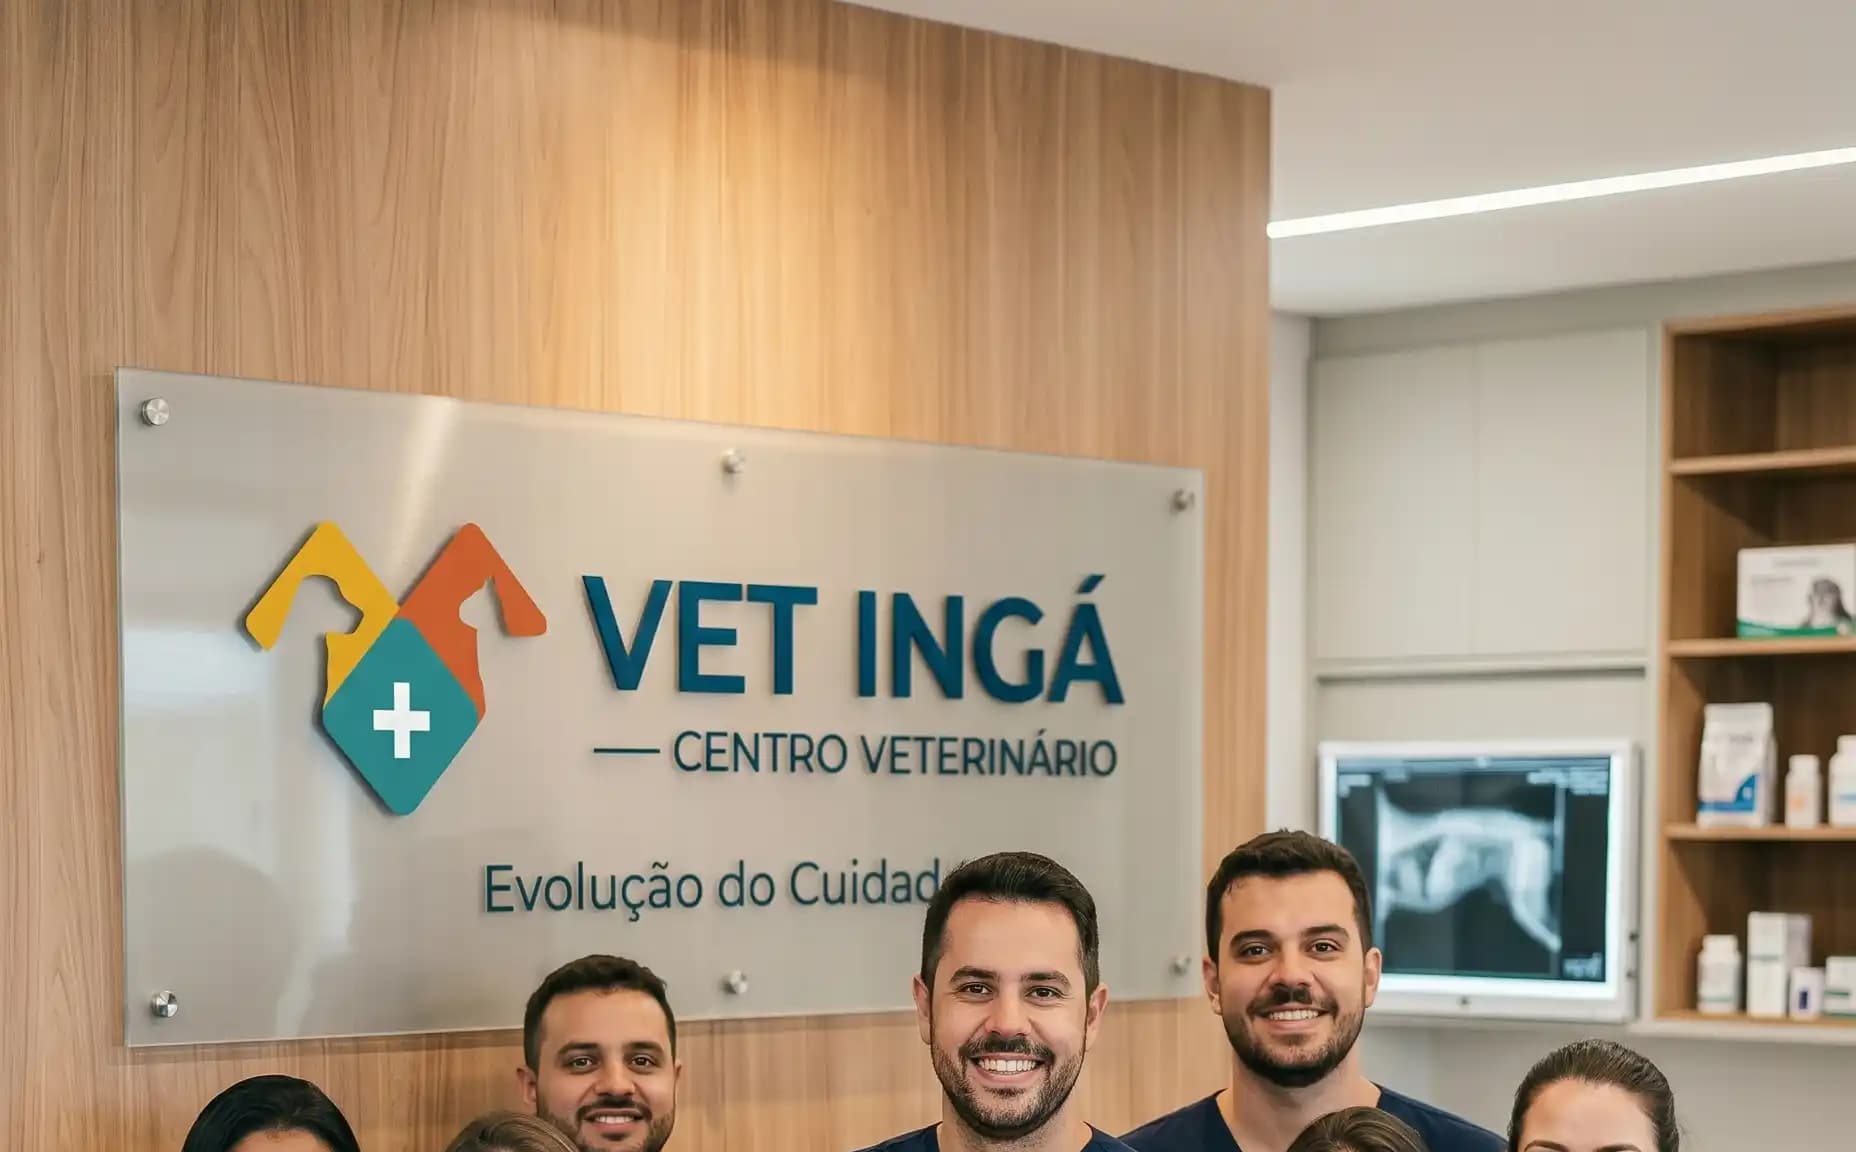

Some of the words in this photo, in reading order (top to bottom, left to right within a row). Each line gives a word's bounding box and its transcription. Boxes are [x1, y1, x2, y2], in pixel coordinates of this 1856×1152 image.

[582, 575, 818, 695] VET
[856, 573, 1125, 706] INGÁ
[673, 730, 848, 774] CENTRO
[860, 728, 1118, 778] VETERINÁRIO
[485, 860, 703, 923] Evolução
[718, 859, 776, 908] do
[790, 857, 940, 906] Cuidad
